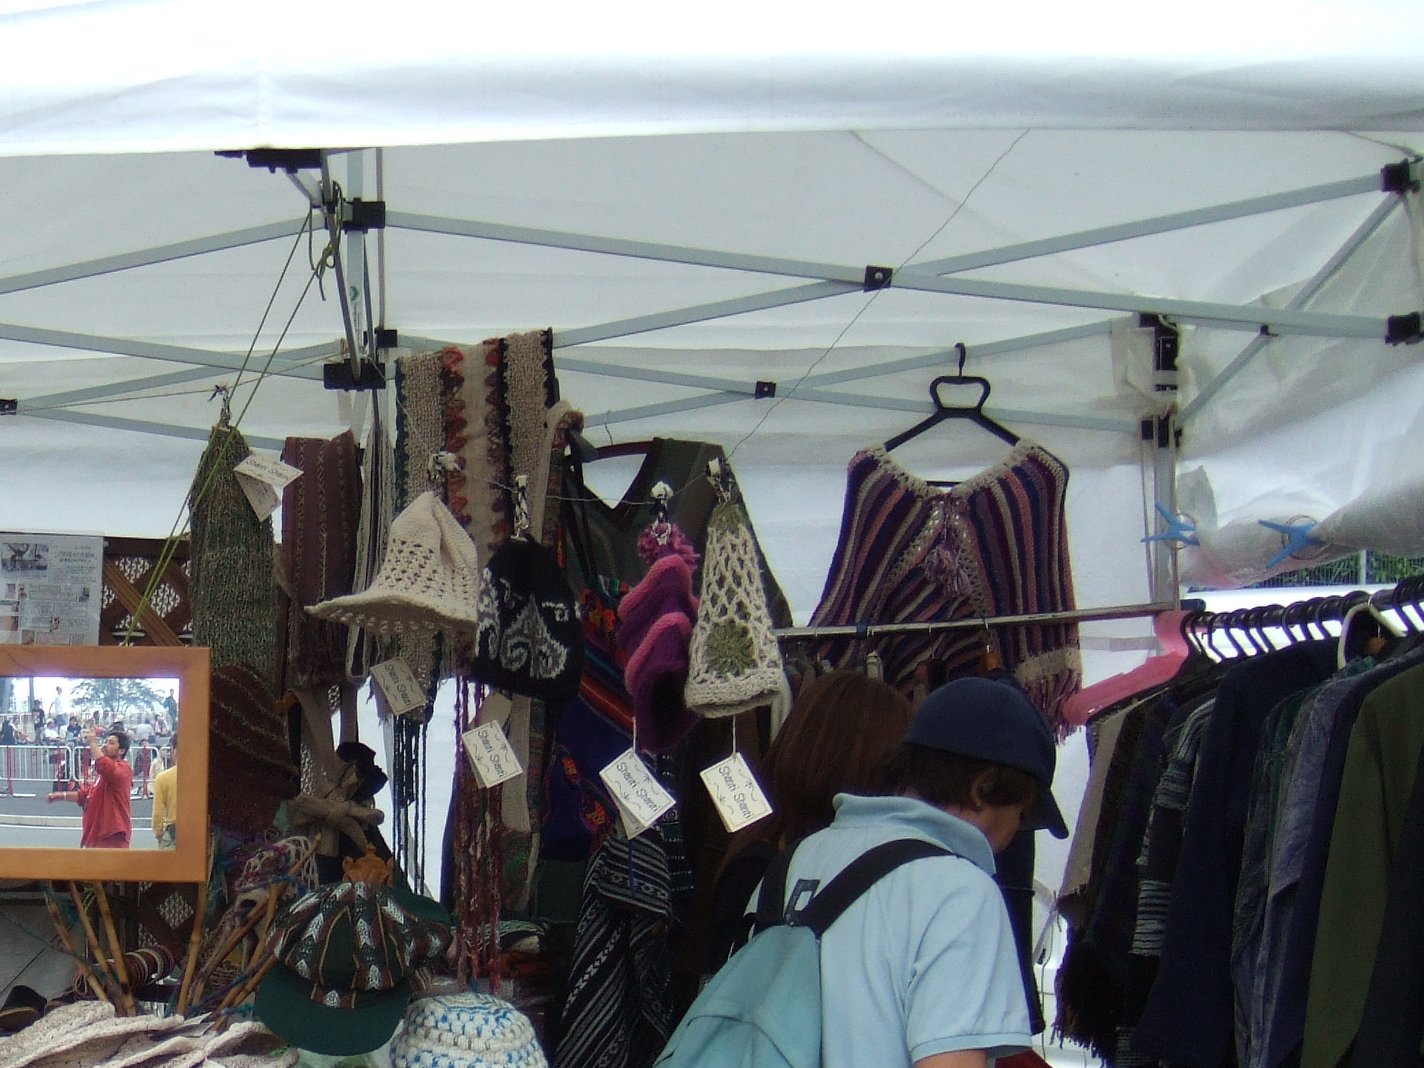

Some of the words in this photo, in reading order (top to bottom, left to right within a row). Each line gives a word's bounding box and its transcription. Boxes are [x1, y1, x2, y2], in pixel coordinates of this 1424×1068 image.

[616, 761, 640, 789] Shanti
[636, 788, 660, 812] Shanti
[718, 765, 739, 792] Shanti
[733, 792, 754, 819] Shanti
